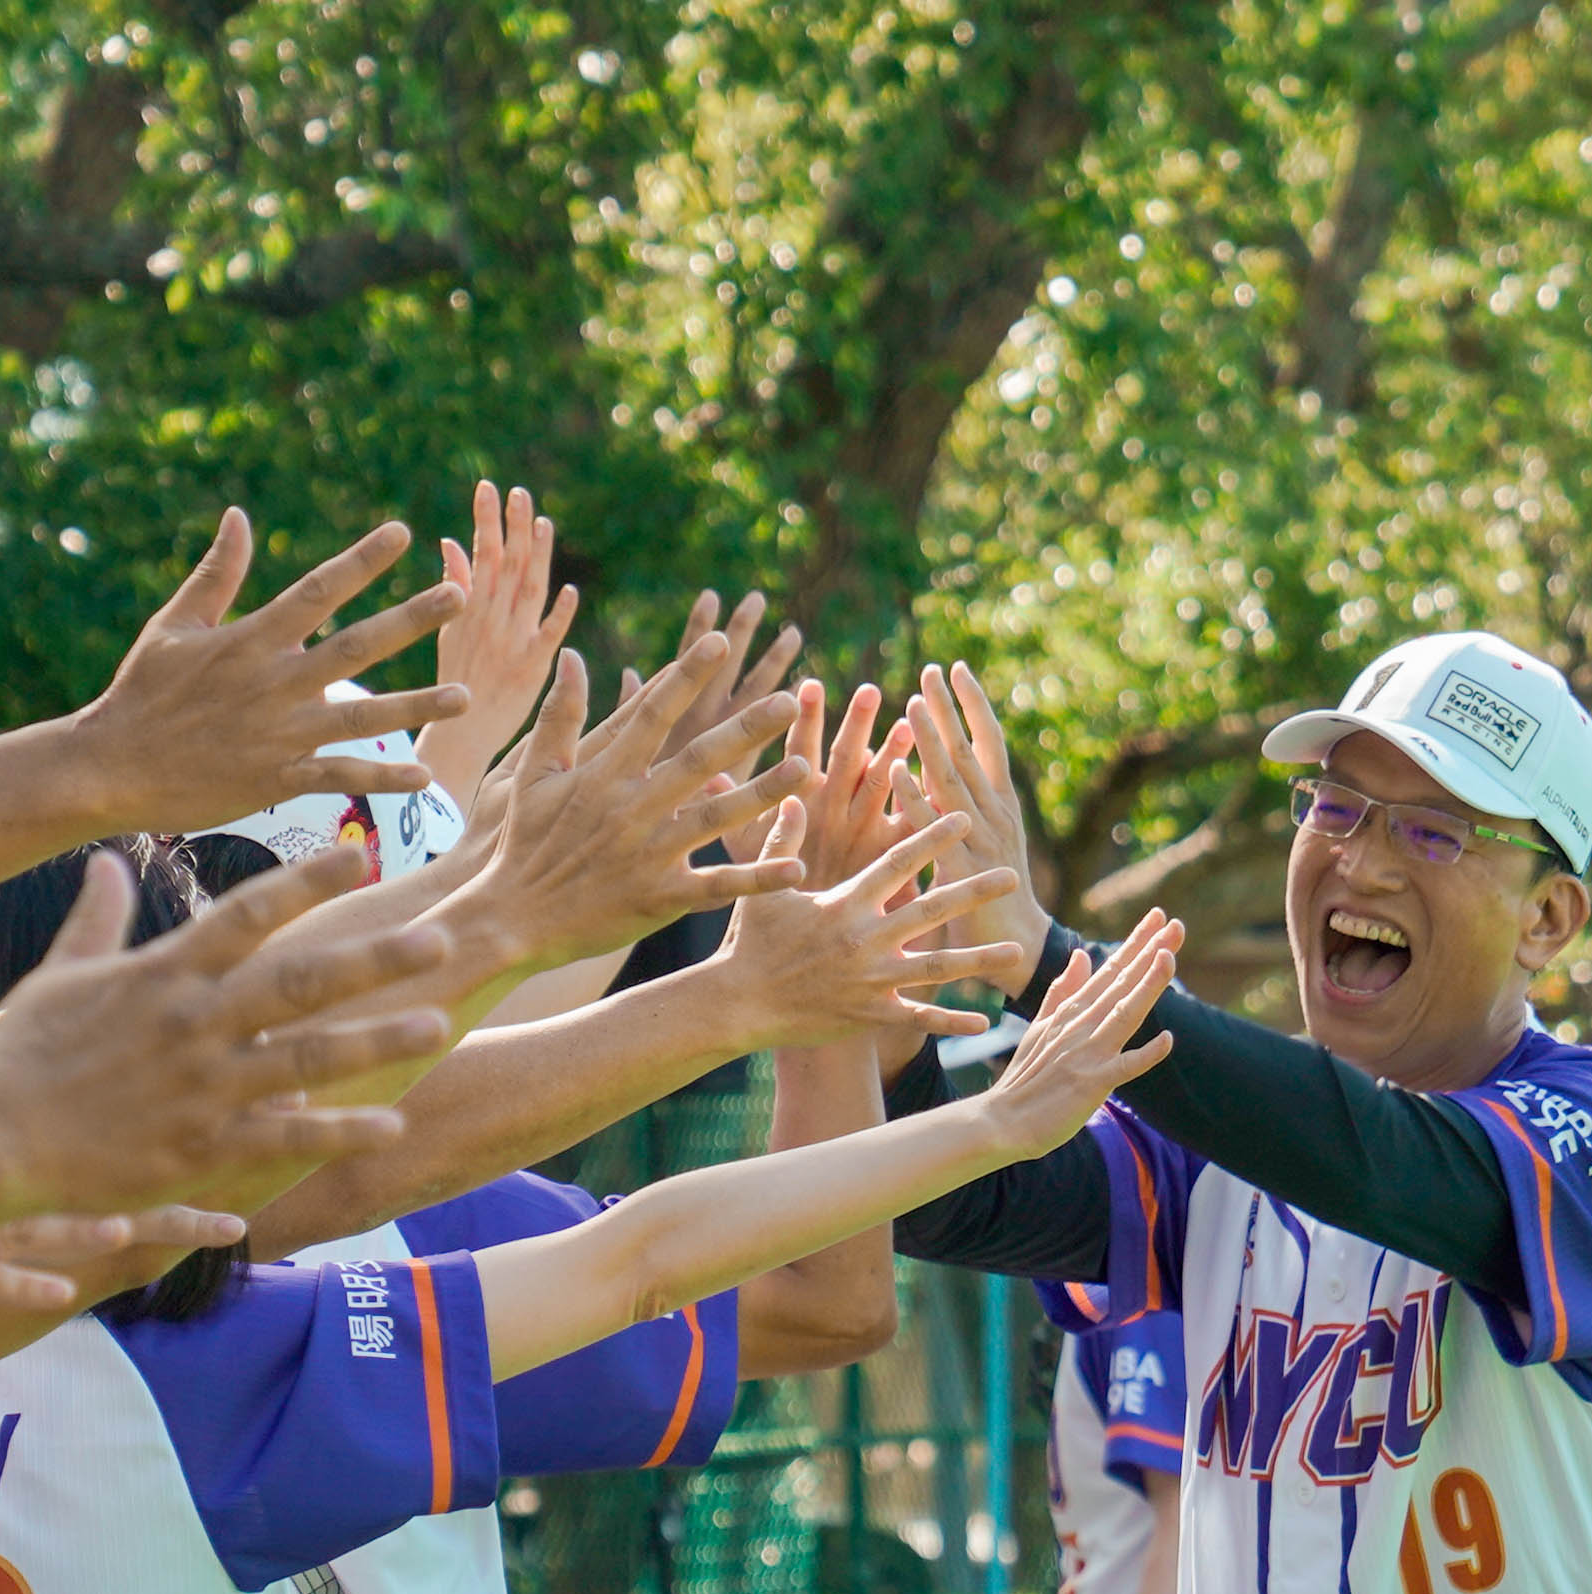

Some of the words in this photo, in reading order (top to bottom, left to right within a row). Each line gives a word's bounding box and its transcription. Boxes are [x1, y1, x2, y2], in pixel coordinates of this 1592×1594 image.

[1447, 693, 1471, 711] Red
[1470, 705, 1492, 722] Bull
[1455, 683, 1528, 732] ORACLE
[1542, 785, 1589, 844] ALPHATAURI
[1110, 1347, 1165, 1388] BA
[1197, 1273, 1453, 1487] NYCU
